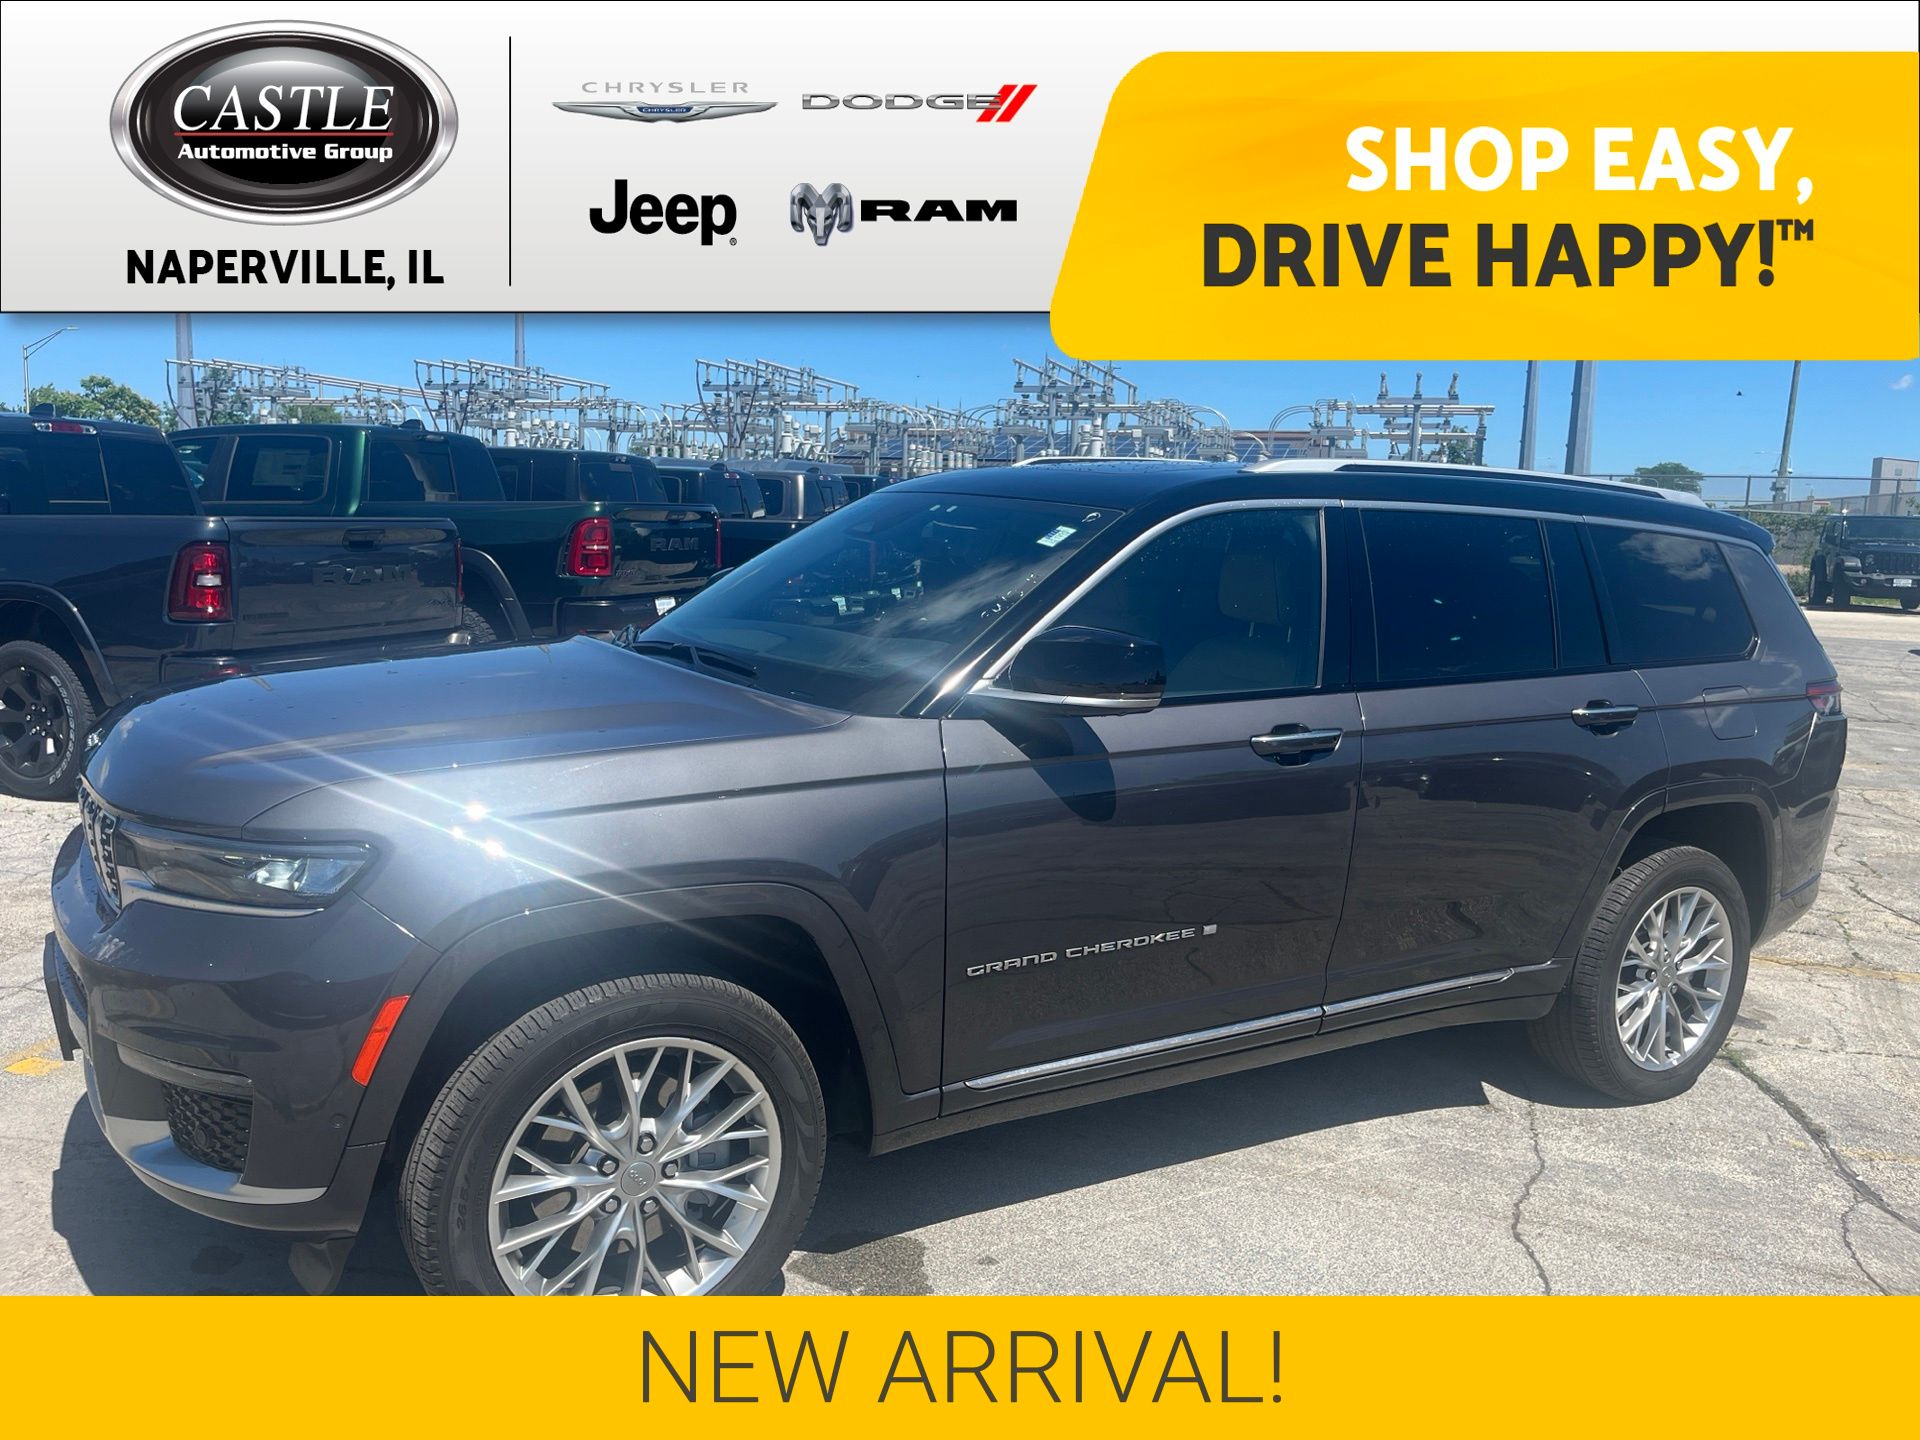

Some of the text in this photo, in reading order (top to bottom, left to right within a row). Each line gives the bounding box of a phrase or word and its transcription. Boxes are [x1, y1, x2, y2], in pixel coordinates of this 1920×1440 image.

[651, 537, 699, 551] RAM
[312, 564, 417, 586] RAM
[966, 951, 1058, 977] GRAND
[1065, 927, 1196, 959] CHEROKEE
